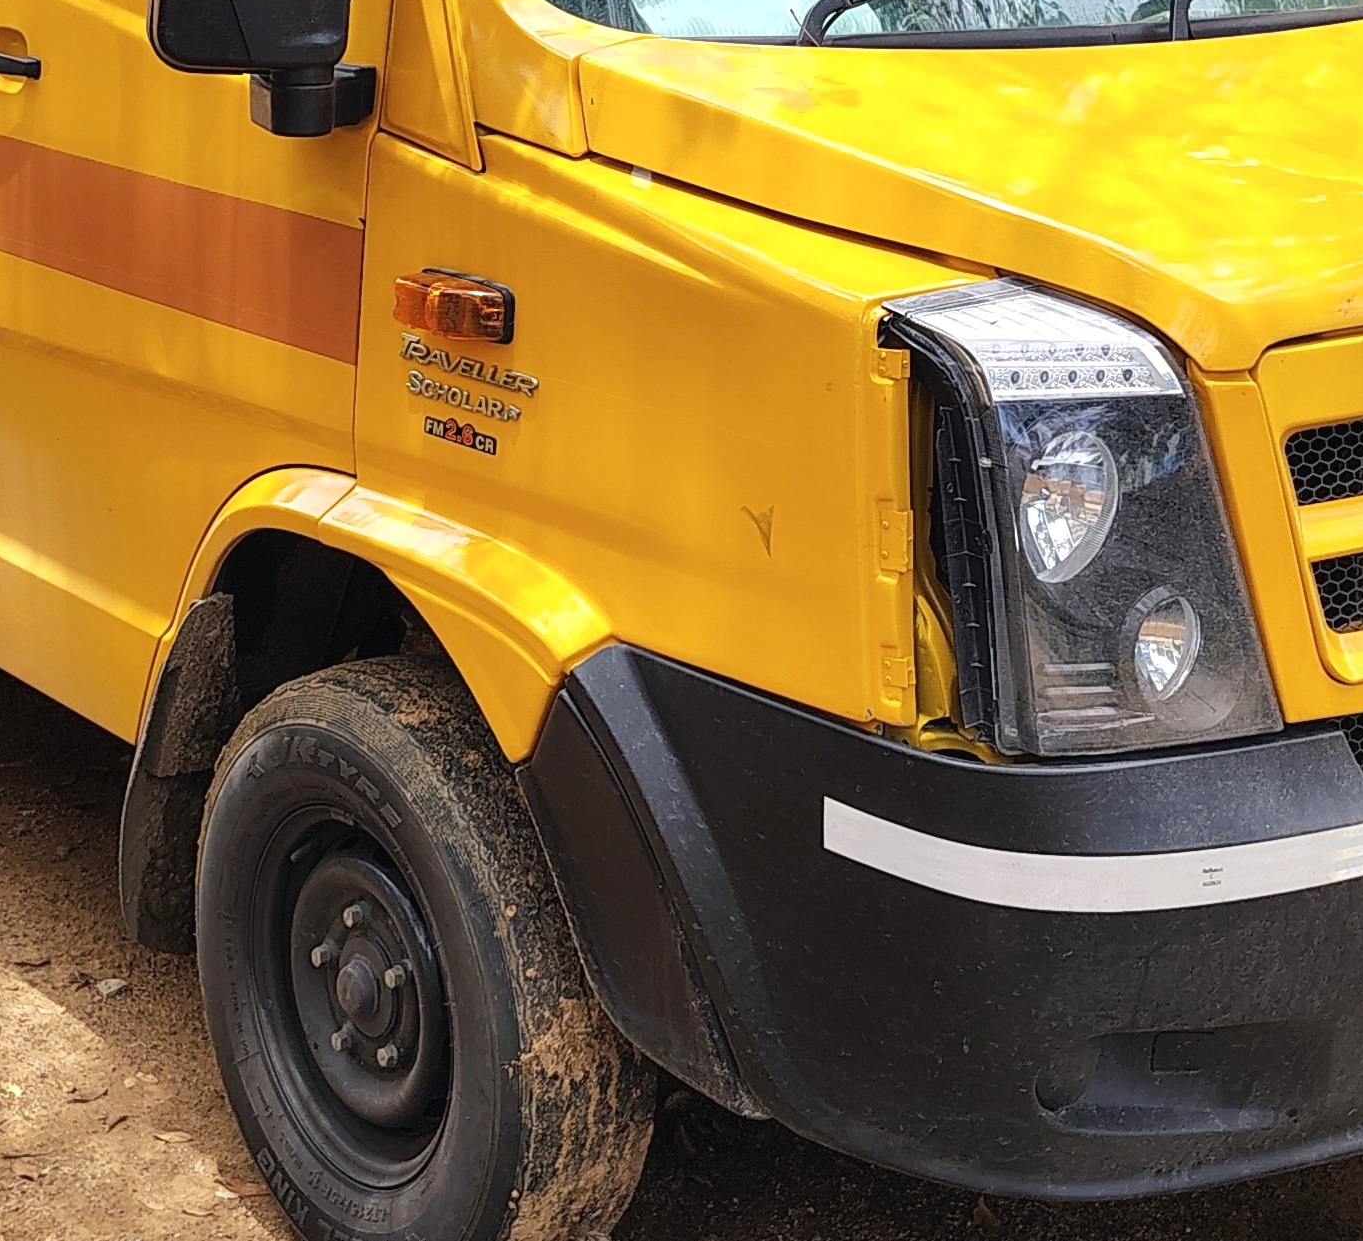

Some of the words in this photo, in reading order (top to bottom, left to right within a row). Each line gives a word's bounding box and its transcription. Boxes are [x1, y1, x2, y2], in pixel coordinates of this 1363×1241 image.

[399, 332, 540, 397] TRAVELLER
[406, 369, 505, 418] SCHOLAR
[425, 417, 444, 437] FM
[444, 419, 474, 446] 2.6
[475, 435, 494, 453] CR
[315, 747, 403, 829] TYRE
